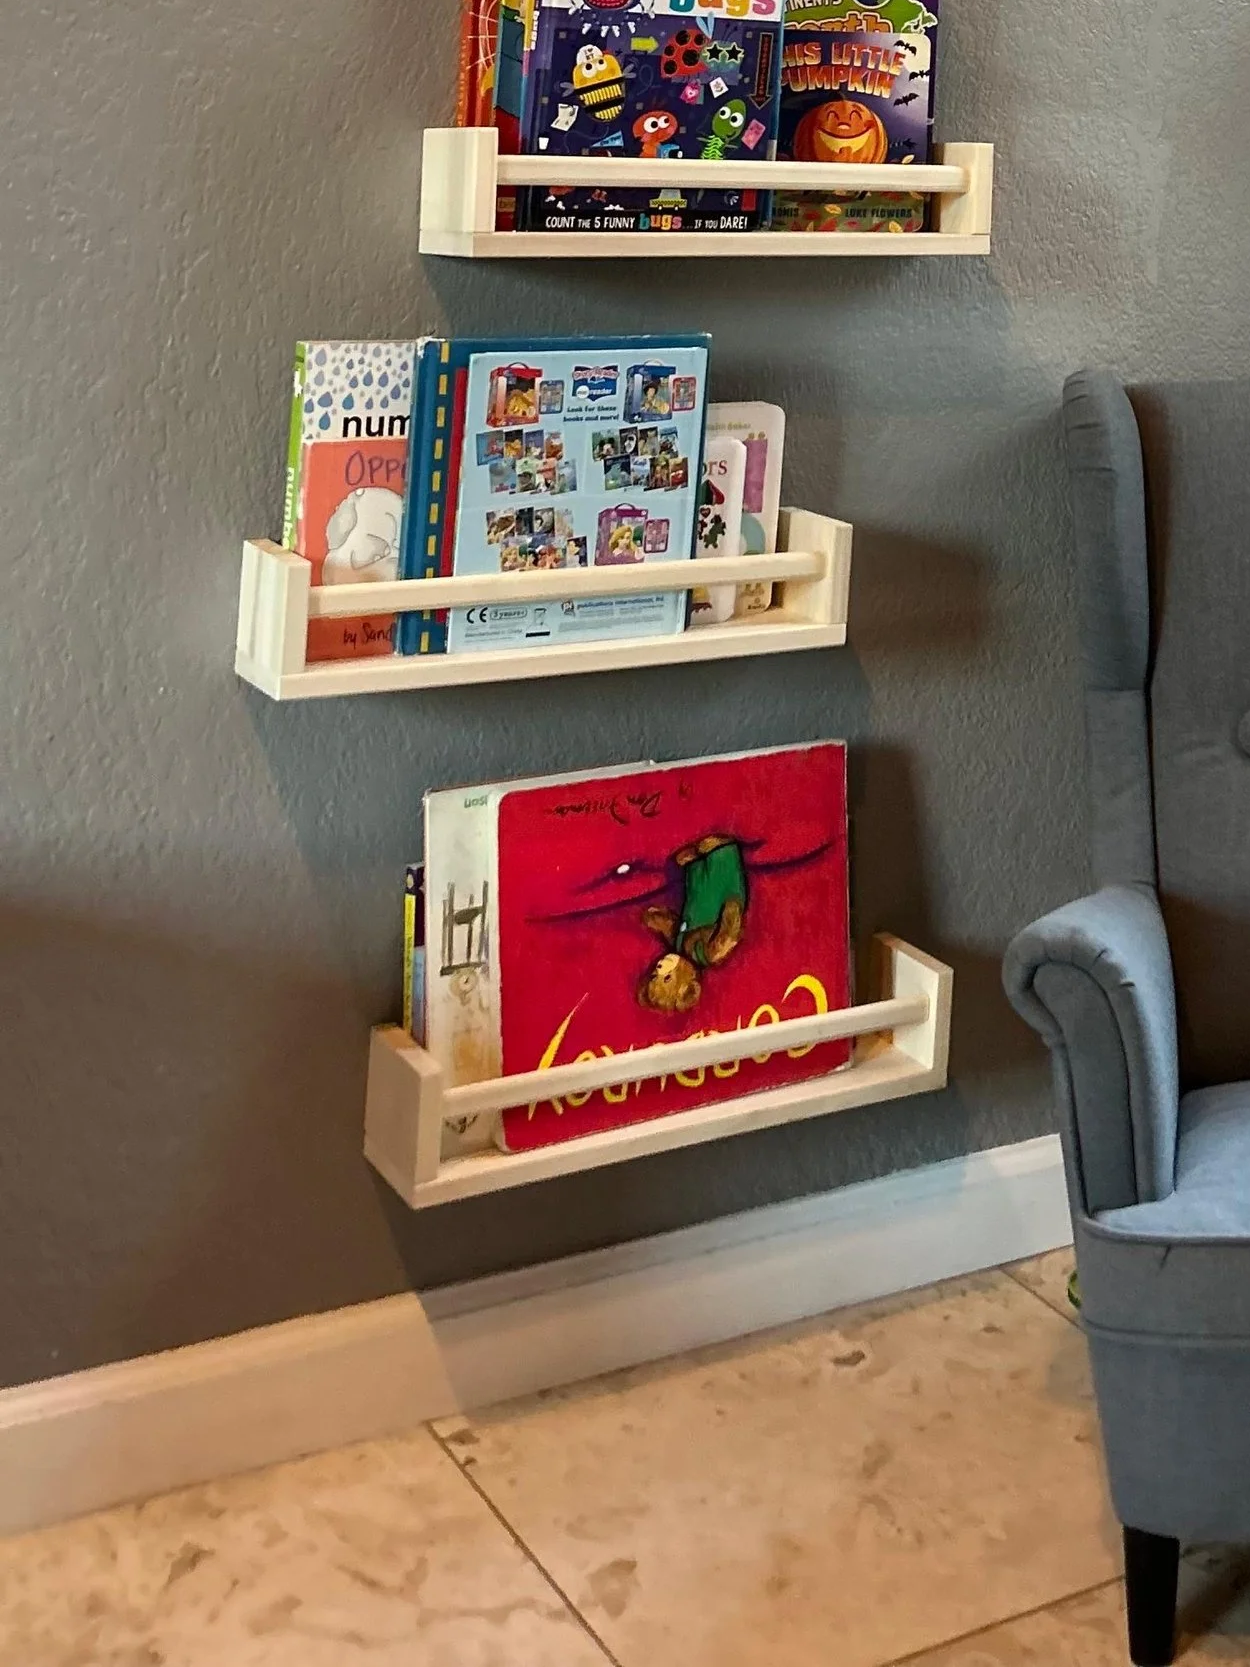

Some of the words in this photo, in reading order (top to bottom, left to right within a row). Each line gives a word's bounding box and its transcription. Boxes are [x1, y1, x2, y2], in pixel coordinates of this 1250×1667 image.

[831, 42, 906, 75] LITTLE
[545, 216, 575, 228] COUNT
[578, 218, 591, 228] THE
[594, 216, 601, 228] 5
[603, 216, 635, 229] FUNNY
[694, 219, 702, 229] IF
[705, 219, 718, 229] YOU
[720, 216, 748, 229] DARE!
[345, 450, 406, 486] OPP
[343, 628, 356, 650] by
[627, 791, 662, 818] Don
